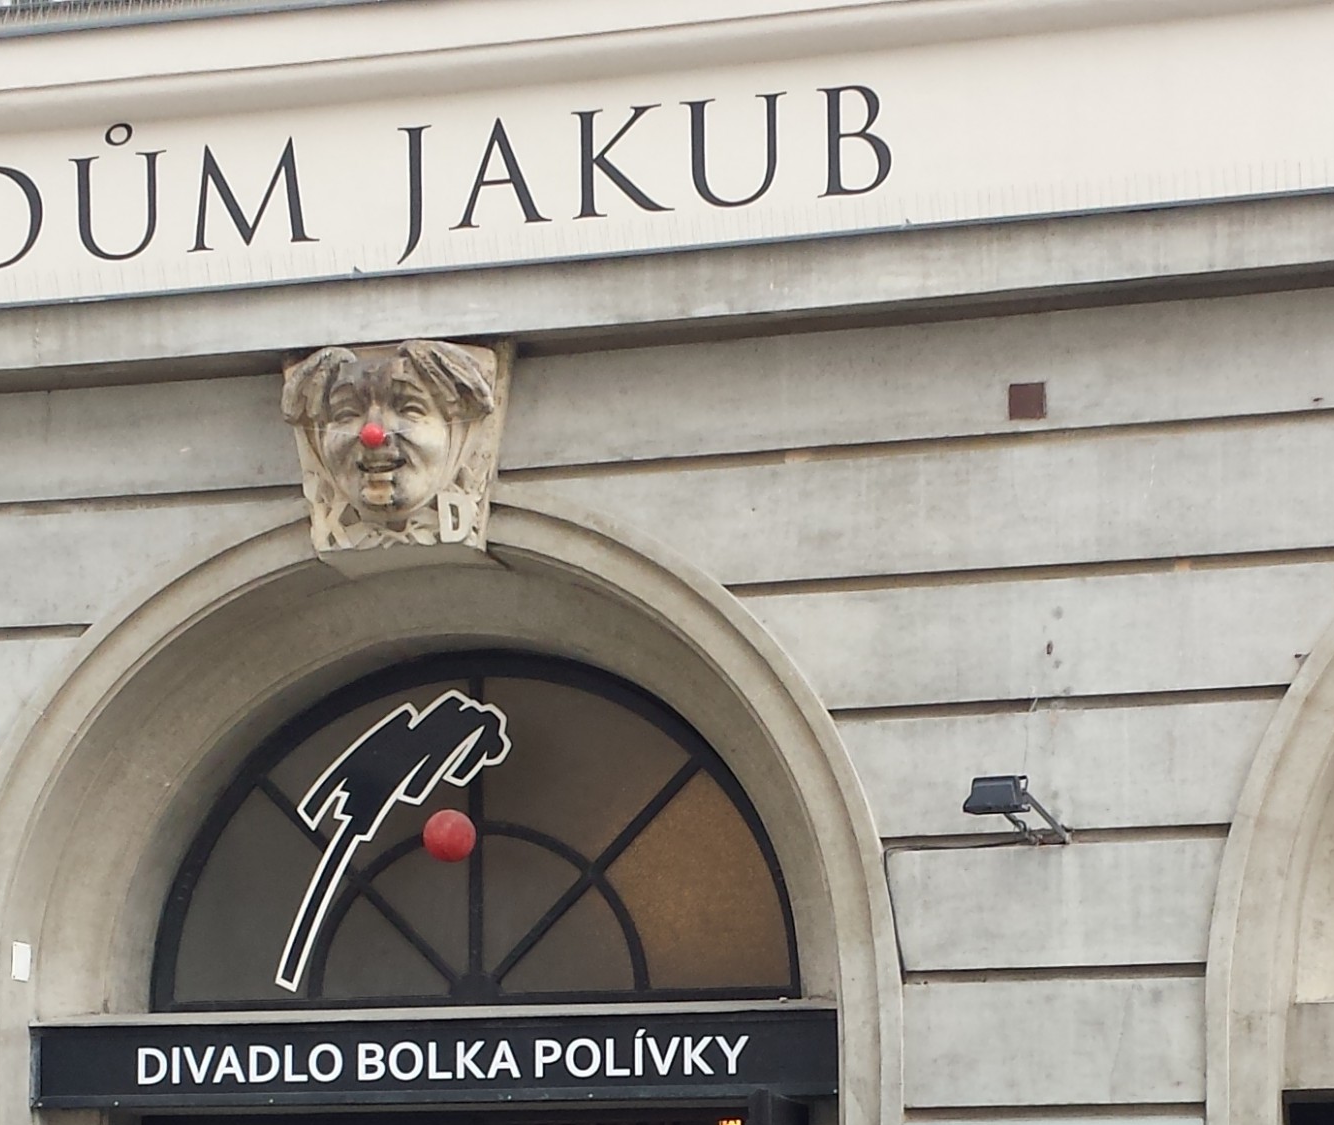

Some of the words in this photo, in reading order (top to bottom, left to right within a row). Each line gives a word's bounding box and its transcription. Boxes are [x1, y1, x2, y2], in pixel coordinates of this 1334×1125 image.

[396, 84, 893, 265] JAKUB
[136, 1043, 344, 1086] DIVADLO
[357, 1040, 521, 1082] BOLKA
[533, 1028, 750, 1079] POLÍVKY
